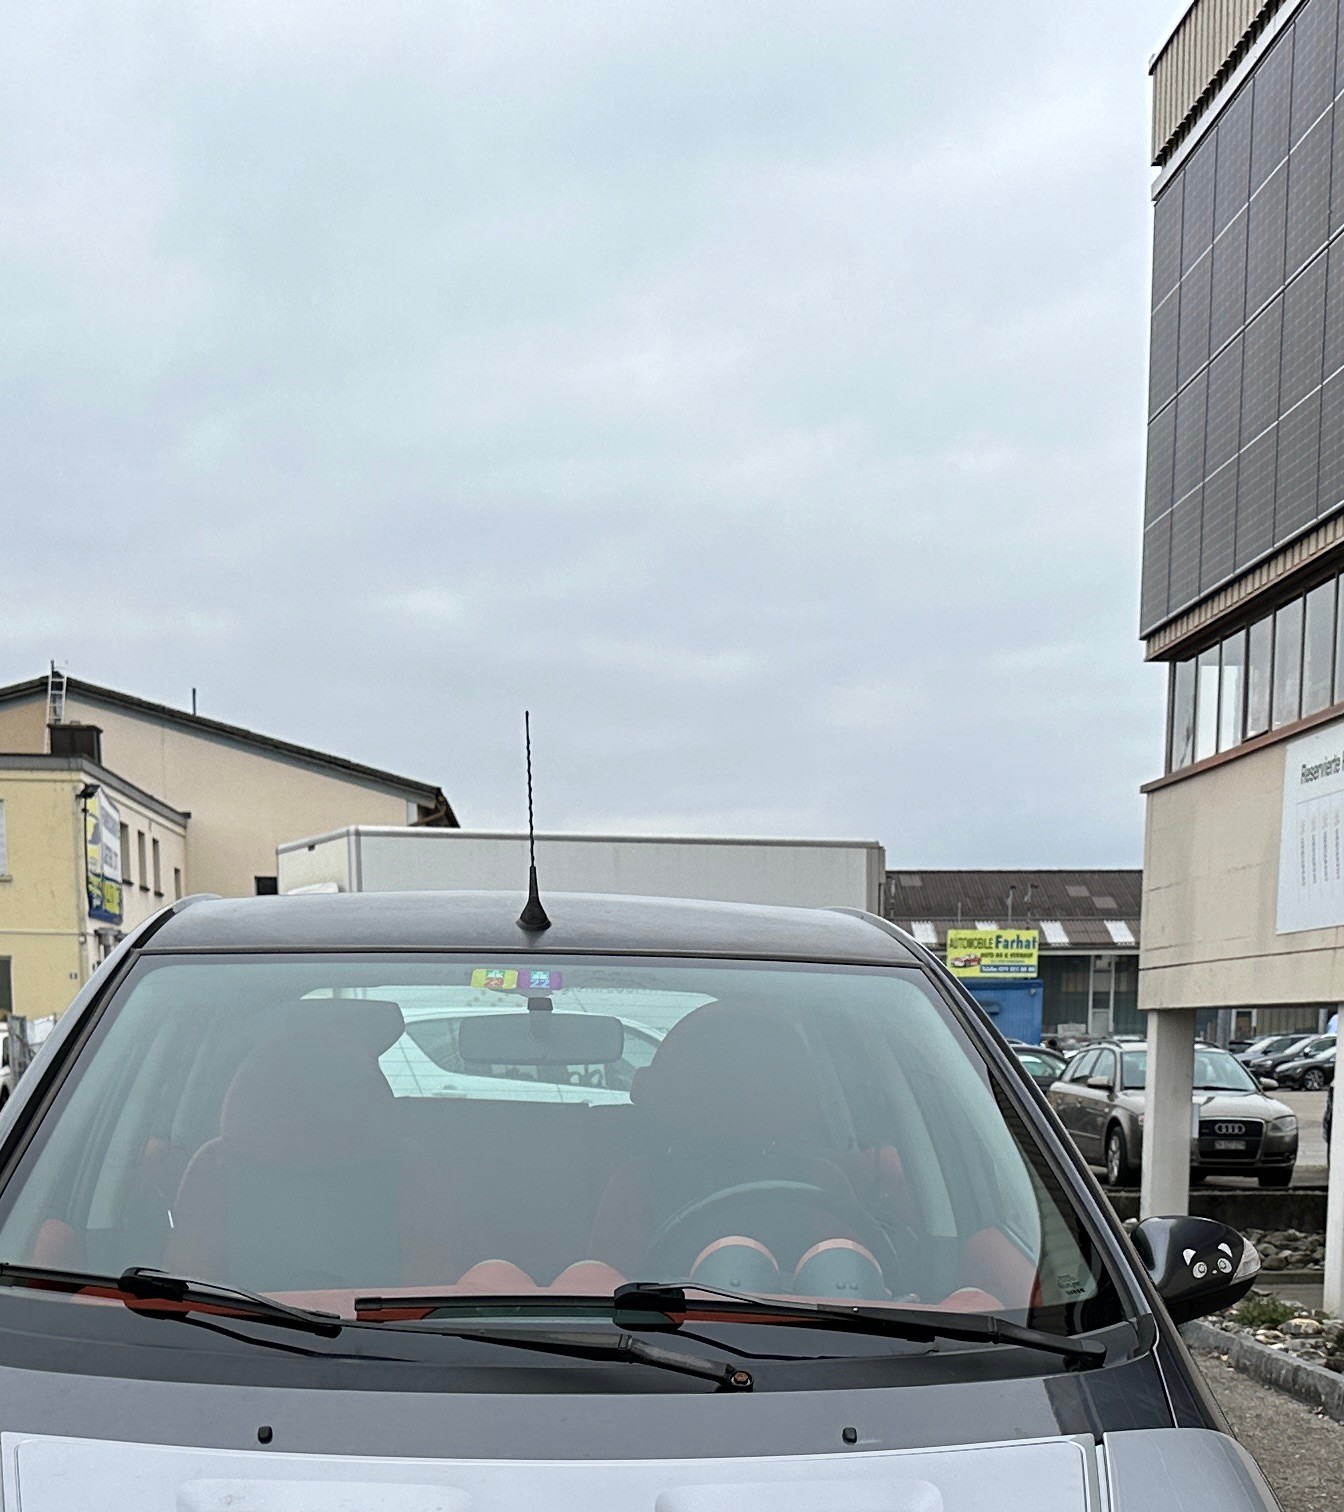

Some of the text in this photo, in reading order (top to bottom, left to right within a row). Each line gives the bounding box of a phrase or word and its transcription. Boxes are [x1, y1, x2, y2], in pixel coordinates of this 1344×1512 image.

[949, 934, 1037, 949] AUTOMOBILE Farhat
[530, 979, 550, 988] 22
